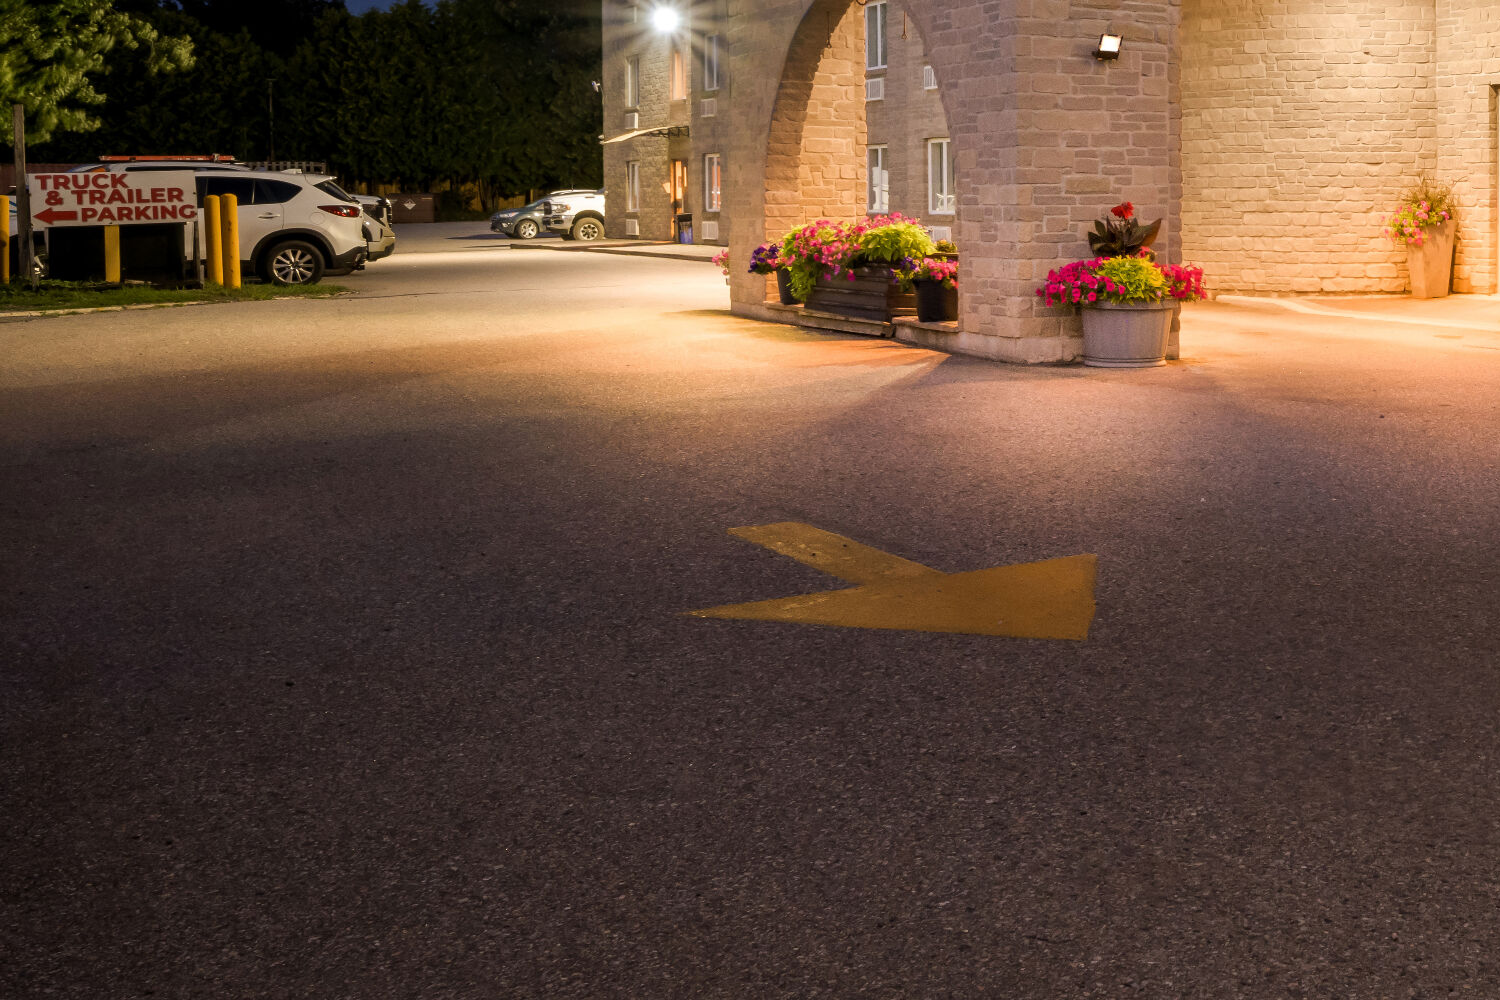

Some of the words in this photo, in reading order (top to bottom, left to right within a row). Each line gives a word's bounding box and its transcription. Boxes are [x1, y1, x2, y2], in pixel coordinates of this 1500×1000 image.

[35, 173, 129, 191] TRUCK
[45, 190, 64, 206] &
[71, 187, 184, 205] TRAILER
[81, 204, 196, 222] PARKING
